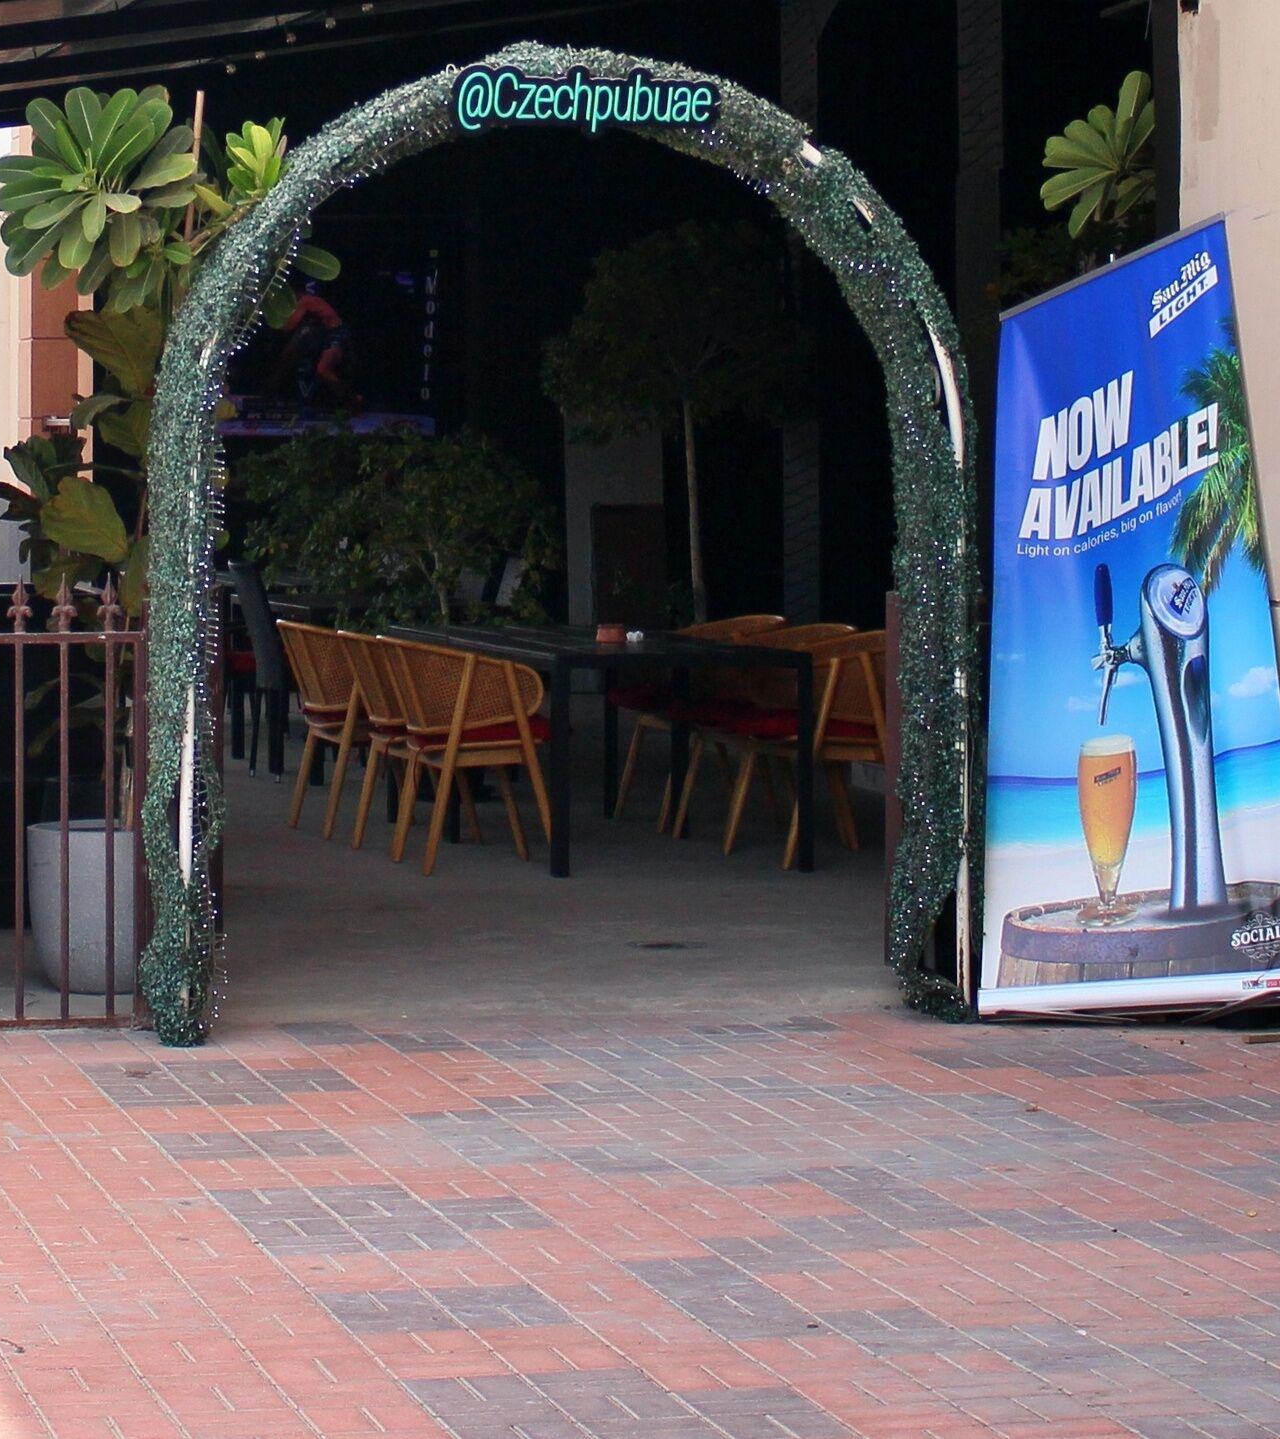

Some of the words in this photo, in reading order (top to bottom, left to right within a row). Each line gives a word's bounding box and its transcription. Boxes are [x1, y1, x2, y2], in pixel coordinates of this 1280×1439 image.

[458, 71, 712, 133] @Czechpubuae
[1151, 280, 1180, 313] San
[1180, 252, 1211, 290] Mig
[1159, 276, 1207, 326] LIGHT
[420, 270, 438, 401] Modelo
[1032, 370, 1134, 480] NOW
[1018, 402, 1219, 539] AVAILABLE!
[1016, 544, 1049, 558] Light
[1053, 546, 1070, 556] on
[1073, 528, 1119, 554] calories,
[1121, 517, 1137, 536] big
[1139, 510, 1153, 524] on
[1155, 490, 1182, 517] flavor!
